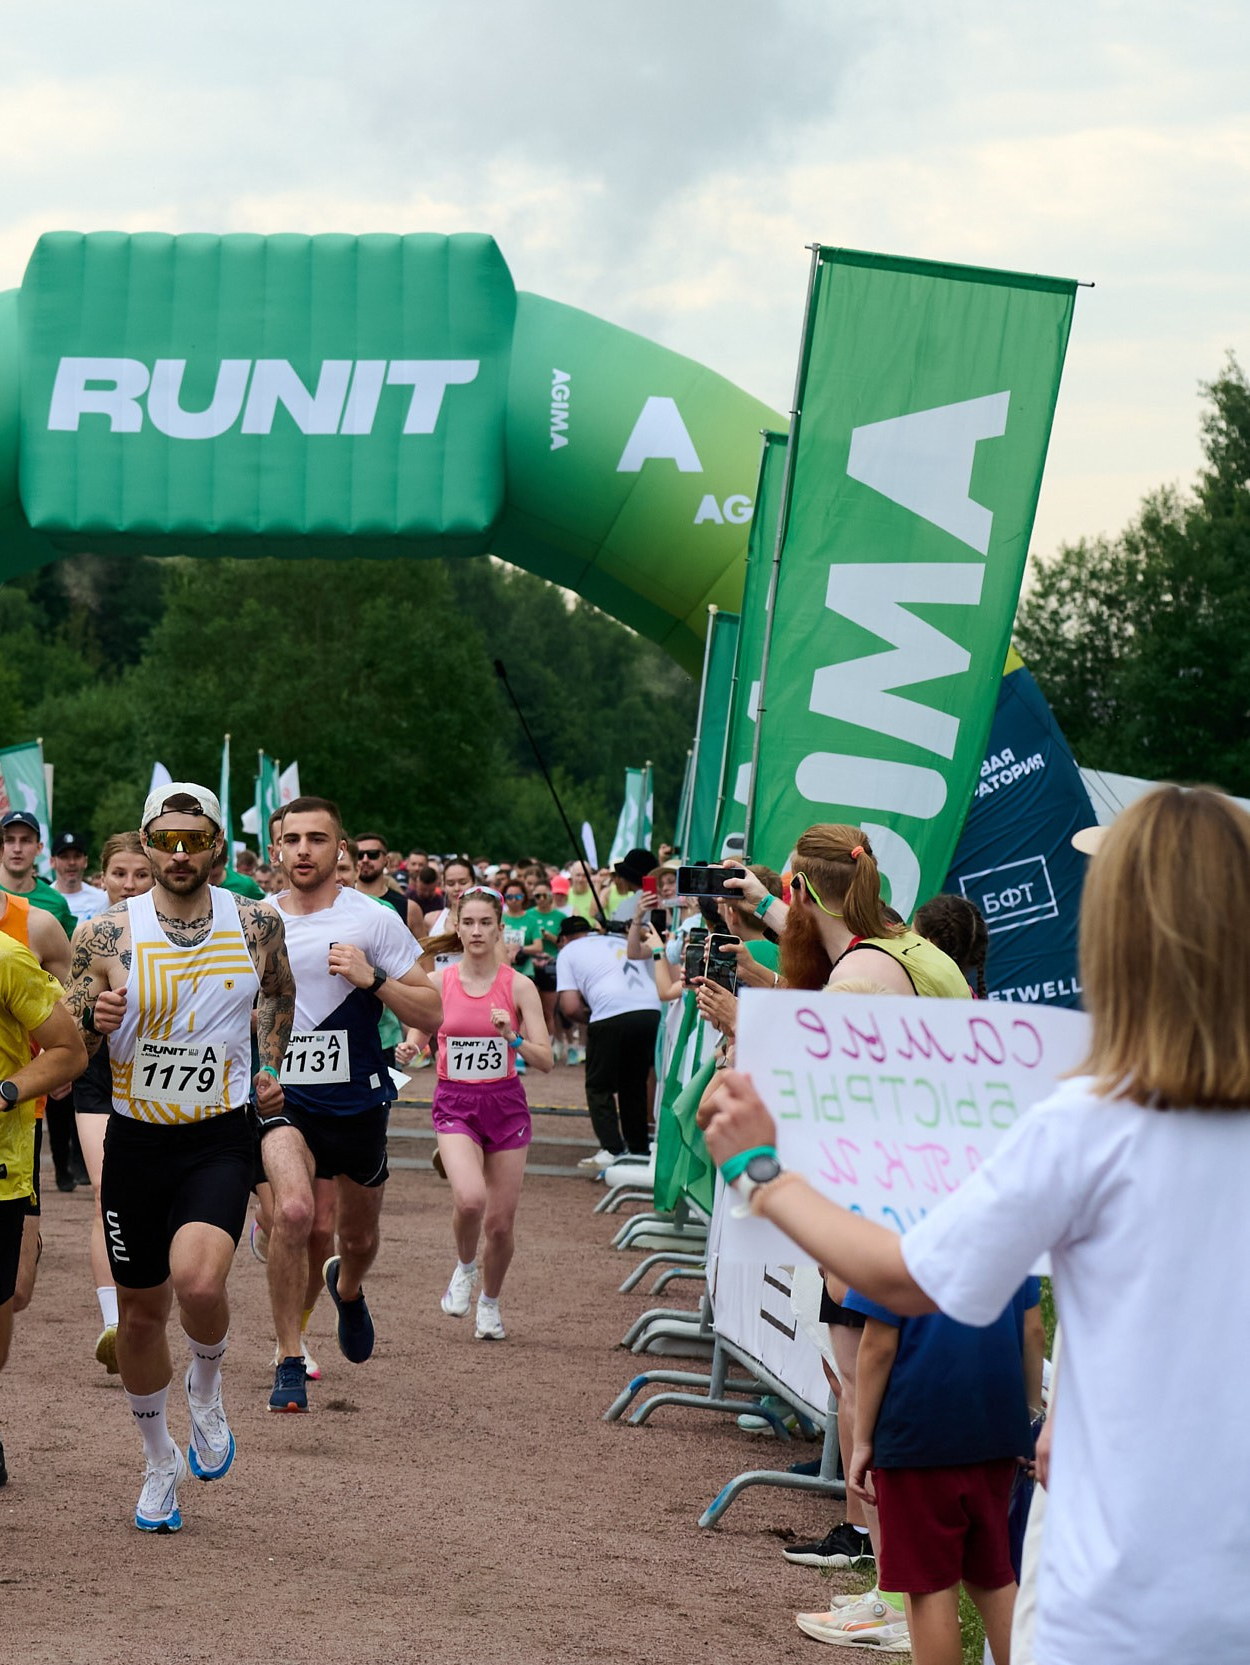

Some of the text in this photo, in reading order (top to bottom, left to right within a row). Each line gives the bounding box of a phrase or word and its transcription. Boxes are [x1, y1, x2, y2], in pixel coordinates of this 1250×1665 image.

[47, 357, 481, 440] RUNIT
[551, 368, 571, 451] AGIMA
[616, 396, 703, 472] A
[974, 753, 1045, 798] АТОРИЯ
[982, 882, 1035, 915] БФТ
[142, 1043, 188, 1056] RUNIT
[201, 1046, 217, 1065] A
[327, 1034, 341, 1050] A
[486, 1040, 498, 1052] A
[284, 1050, 340, 1073] 1131
[453, 1052, 502, 1070] 1153
[142, 1062, 216, 1093] 1179
